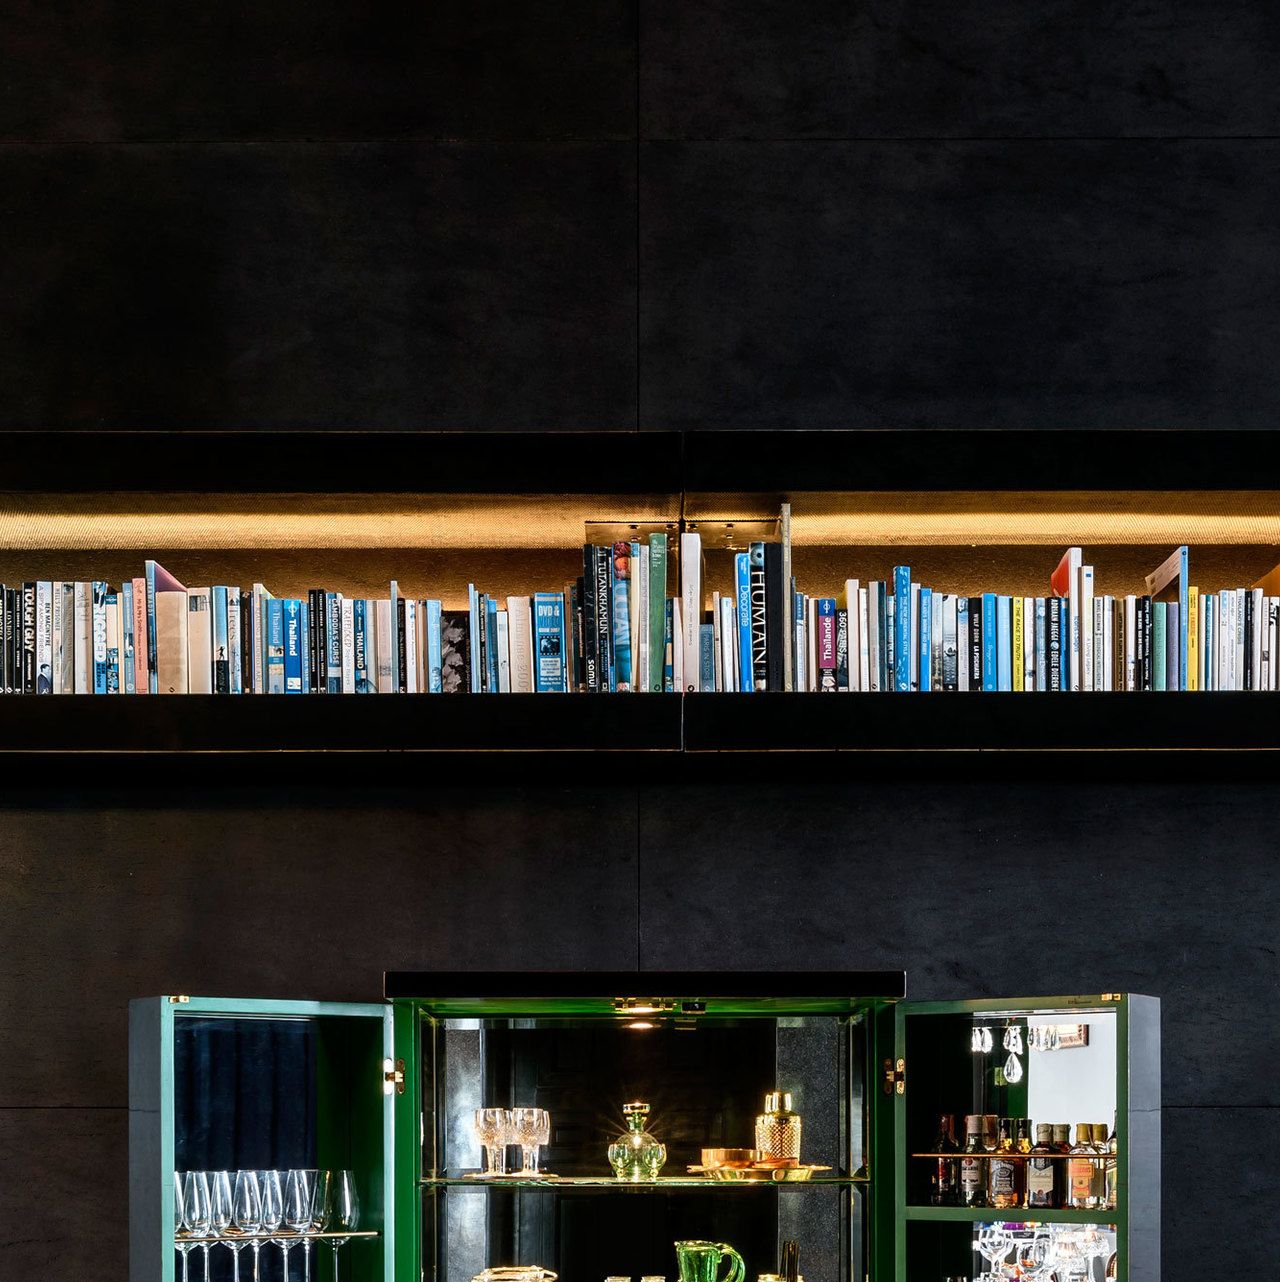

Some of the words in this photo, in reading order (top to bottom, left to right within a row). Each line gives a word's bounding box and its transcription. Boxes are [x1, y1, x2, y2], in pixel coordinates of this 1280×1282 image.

[25, 588, 34, 626] TOUGH
[538, 605, 552, 616] DVD
[598, 562, 607, 633] TUTANKHAMUN
[740, 585, 750, 626] Decorate
[95, 604, 106, 662] RIGGED
[229, 608, 239, 640] Trees
[751, 571, 766, 664] HUMAN
[24, 628, 34, 652] GUY
